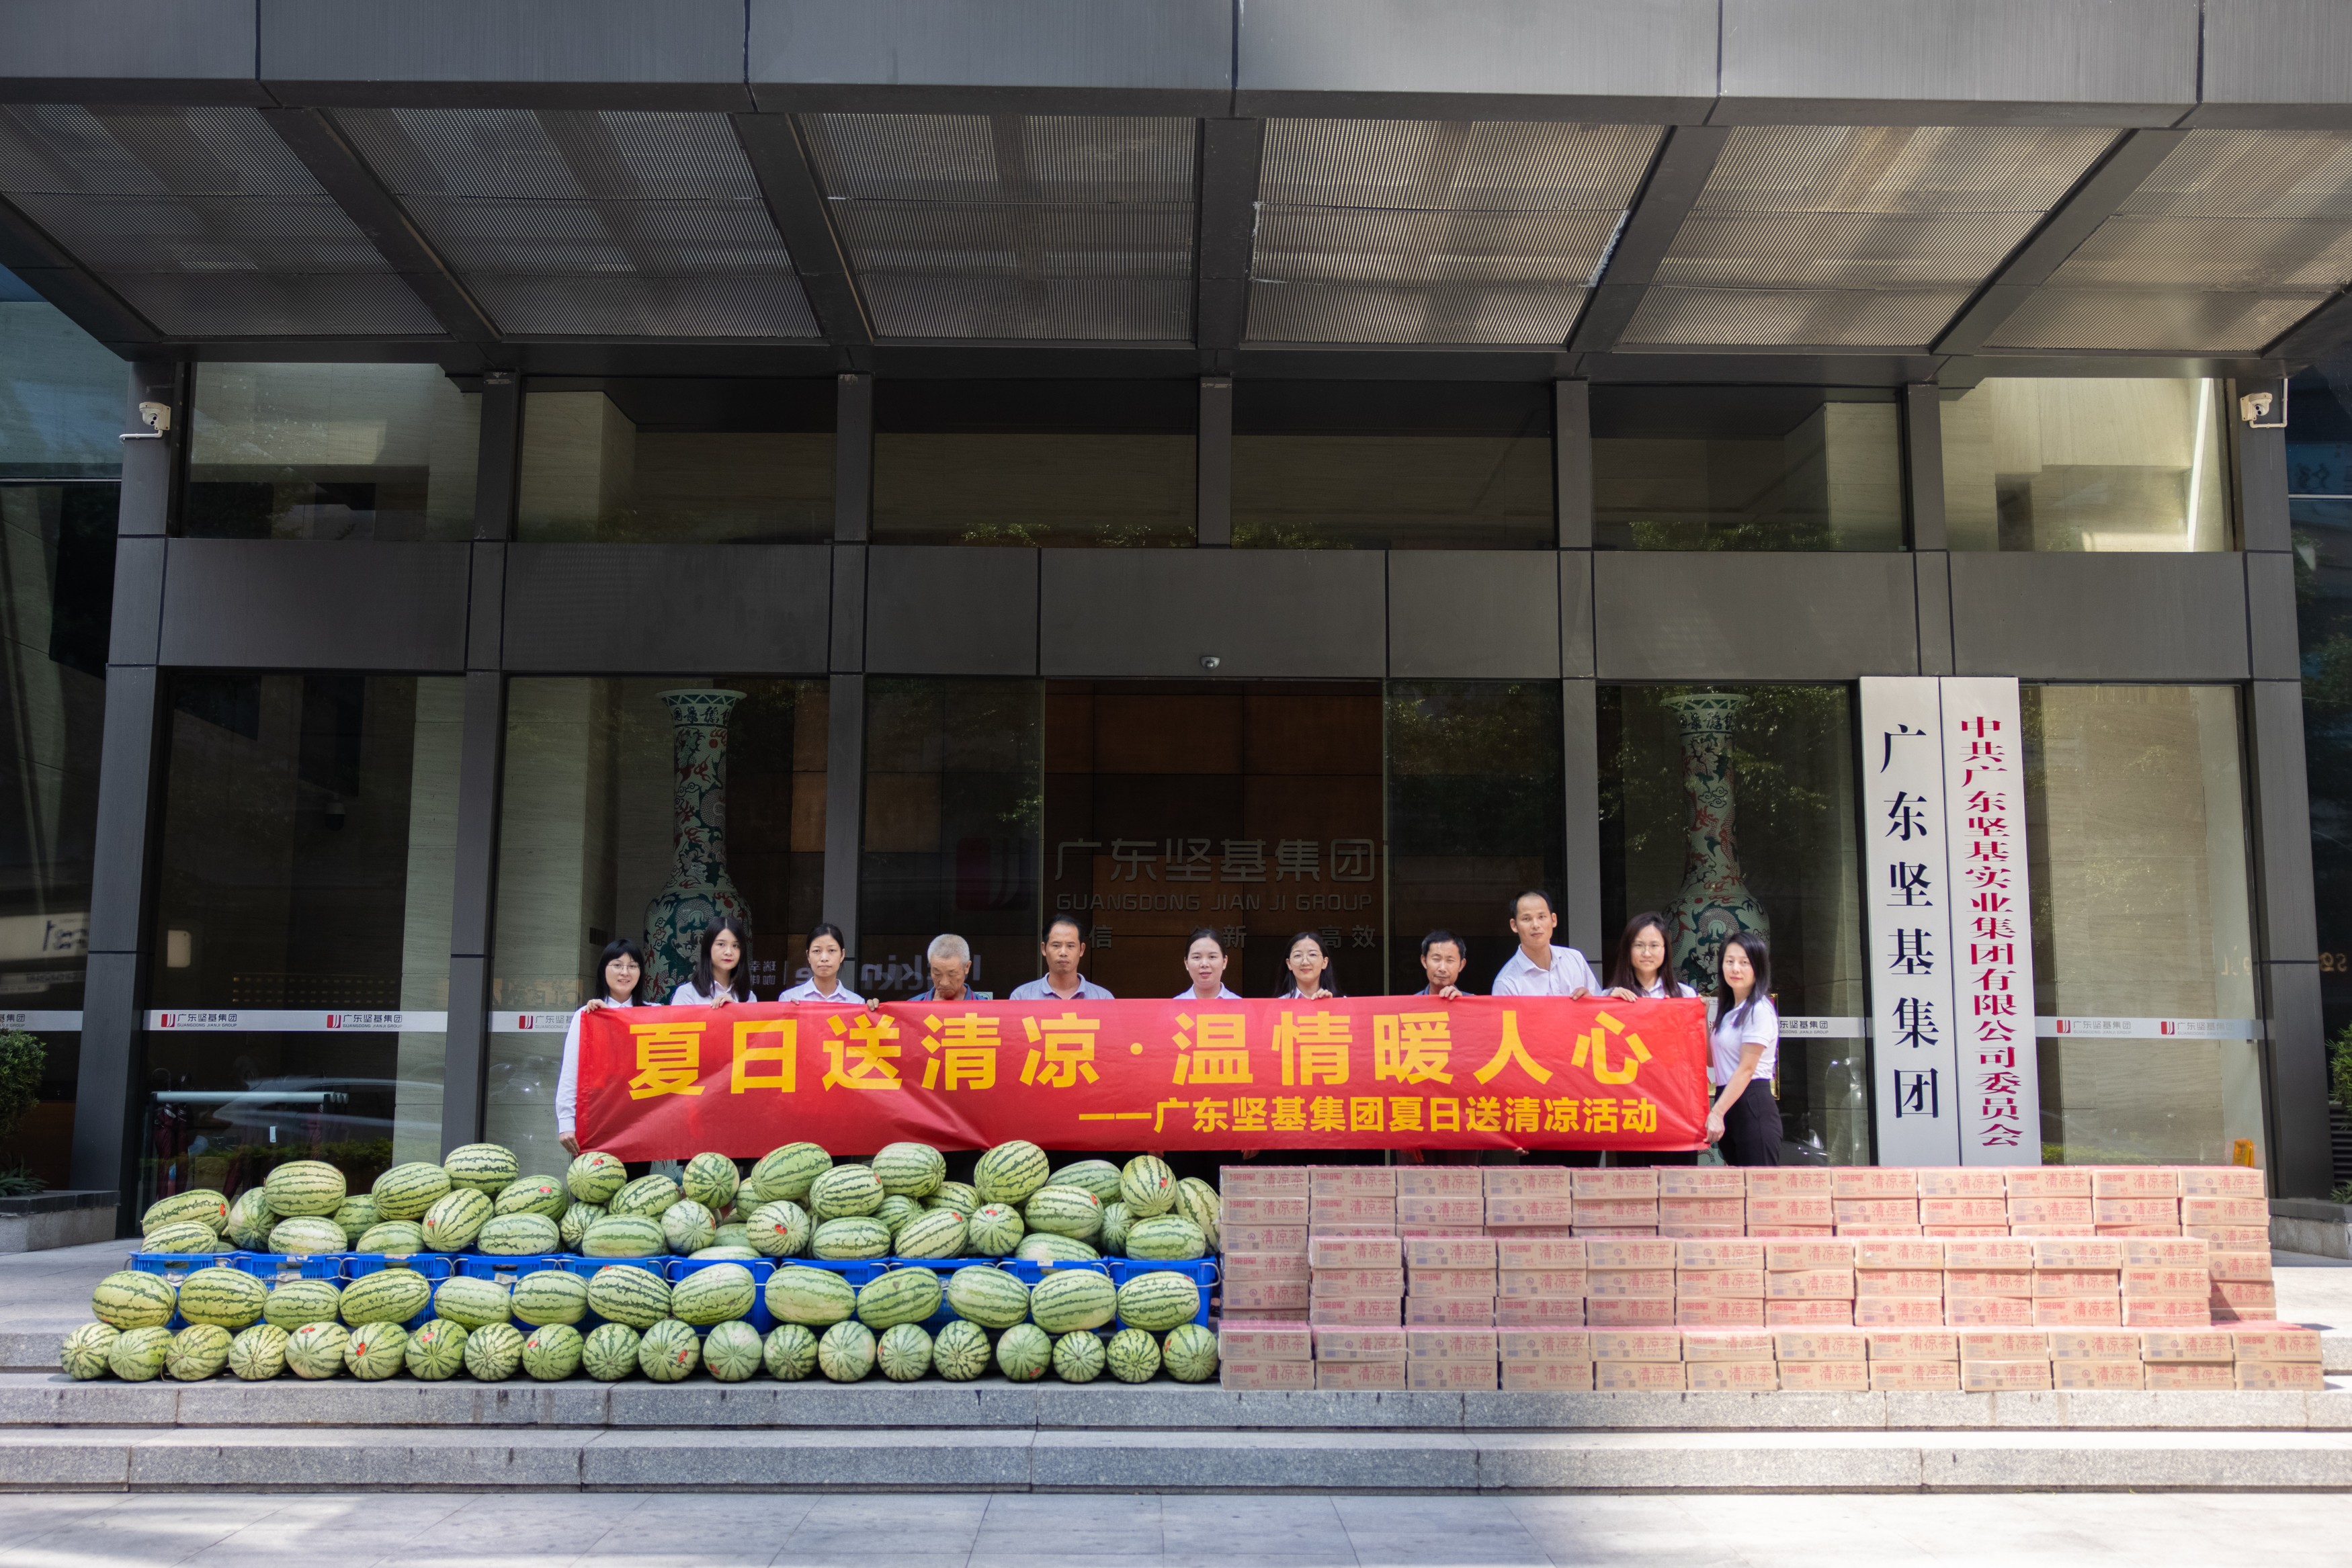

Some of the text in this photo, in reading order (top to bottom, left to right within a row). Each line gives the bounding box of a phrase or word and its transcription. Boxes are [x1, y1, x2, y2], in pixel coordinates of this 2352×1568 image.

[1055, 838, 1375, 882] 广东坚基集团
[1056, 893, 1372, 910] GUANGDONG JIAN JI GROUP
[1880, 724, 1939, 1119] 广东坚基集团
[1089, 924, 1113, 949] 信
[1318, 924, 1376, 949] 高效
[1960, 716, 2023, 1148] 中共广东坚基实业集团有限公司委员会
[177, 1013, 237, 1022] 广东坚基集团
[343, 1014, 402, 1022] 广东坚基集团
[536, 1015, 574, 1024] 广东坚基
[1779, 1020, 1828, 1029] 东坚基集团
[2073, 1020, 2131, 1029] 广东坚基集团
[2177, 1022, 2234, 1031] 广东坚基集团
[629, 1010, 1652, 1100] 夏日送清凉·温情暖人心
[1263, 1172, 1304, 1188] 清凉茶
[1351, 1172, 1391, 1188] 清凉茶
[1438, 1175, 1478, 1191] 清凉茶
[1524, 1174, 1564, 1190] 清凉茶
[1612, 1174, 1652, 1190] 清凉茶
[1699, 1173, 1740, 1189] 清凉茶
[1786, 1173, 1826, 1189] 清凉茶
[1872, 1174, 1912, 1190] 清凉茶
[1959, 1174, 1999, 1190] 清凉茶
[2046, 1173, 2086, 1189] 清凉茶
[2134, 1174, 2174, 1190] 清凉茶
[2218, 1174, 2259, 1190] 清凉茶
[1264, 1200, 1304, 1216] 清凉茶
[1349, 1199, 1390, 1215] 清凉茶
[1438, 1201, 1478, 1217] 清凉茶
[1527, 1201, 1567, 1217] 清凉茶
[1613, 1202, 1653, 1218] 清凉茶
[1699, 1201, 1739, 1217] 清凉茶
[1787, 1201, 1827, 1217] 清凉茶
[1873, 1202, 1913, 1218] 清凉茶
[1962, 1201, 2002, 1217] 清凉茶
[2048, 1201, 2088, 1217] 清凉茶
[2134, 1202, 2174, 1218] 清凉茶
[2223, 1201, 2263, 1217] 清凉茶
[1262, 1229, 1302, 1245] 清凉茶
[2224, 1229, 2265, 1245] 清凉茶
[1354, 1243, 1394, 1259] 清凉茶
[1450, 1244, 1490, 1260] 清凉茶
[1541, 1244, 1581, 1260] 清凉茶
[1628, 1244, 1668, 1260] 清凉茶
[1718, 1245, 1759, 1261] 清凉茶
[1808, 1246, 1848, 1262] 清凉茶
[1896, 1244, 1937, 1260] 清凉茶
[1986, 1244, 2027, 1260] 清凉茶
[2075, 1244, 2115, 1260] 清凉茶
[2164, 1244, 2204, 1260] 清凉茶
[1265, 1256, 1306, 1272] 清凉茶
[2228, 1258, 2268, 1274] 清凉茶
[1355, 1272, 1396, 1288] 清凉茶
[1452, 1272, 1492, 1289] 清凉茶
[1540, 1273, 1580, 1289] 清凉茶
[1629, 1273, 1669, 1289] 清凉茶
[1718, 1273, 1759, 1289] 清凉茶
[1808, 1275, 1848, 1291] 清凉茶
[1898, 1272, 1938, 1289] 清凉茶
[1985, 1275, 2025, 1291] 清凉茶
[2072, 1275, 2113, 1291] 清凉茶
[2165, 1272, 2206, 1289] 清凉茶
[1264, 1285, 1304, 1301] 清凉茶
[2231, 1285, 2271, 1301] 清凉茶
[1353, 1301, 1394, 1317] 清凉茶
[1449, 1302, 1489, 1318] 清凉茶
[1536, 1301, 1576, 1317] 清凉茶
[1628, 1301, 1669, 1317] 清凉茶
[1716, 1302, 1757, 1318] 清凉茶
[1806, 1301, 1847, 1317] 清凉茶
[1898, 1302, 1938, 1318] 清凉茶
[1986, 1302, 2026, 1318] 清凉茶
[2075, 1301, 2115, 1317] 清凉茶
[2165, 1301, 2205, 1317] 清凉茶
[1263, 1335, 1303, 1351] 清凉茶
[1359, 1336, 1400, 1352] 清凉茶
[1450, 1336, 1490, 1352] 清凉茶
[1542, 1336, 1583, 1352] 清凉茶
[1632, 1336, 1673, 1352] 清凉茶
[1726, 1336, 1767, 1352] 清凉茶
[1818, 1336, 1858, 1352] 清凉茶
[1910, 1334, 1950, 1350] 清凉茶
[2001, 1335, 2042, 1351] 清凉茶
[2092, 1336, 2132, 1352] 清凉茶
[2187, 1336, 2227, 1352] 清凉茶
[2274, 1336, 2314, 1352] 清凉茶
[1266, 1364, 1306, 1381] 清凉茶
[1358, 1365, 1398, 1381] 清凉茶
[1450, 1366, 1490, 1382] 清凉茶
[1545, 1365, 1585, 1381] 清凉茶
[1638, 1366, 1679, 1383] 清凉茶
[1729, 1366, 1769, 1382] 清凉茶
[1820, 1365, 1860, 1381] 清凉茶
[1913, 1365, 1954, 1381] 清凉茶
[2006, 1366, 2046, 1382] 清凉茶
[2098, 1366, 2138, 1382] 清凉茶
[2188, 1366, 2228, 1382] 清凉茶
[2277, 1366, 2317, 1382] 清凉茶
